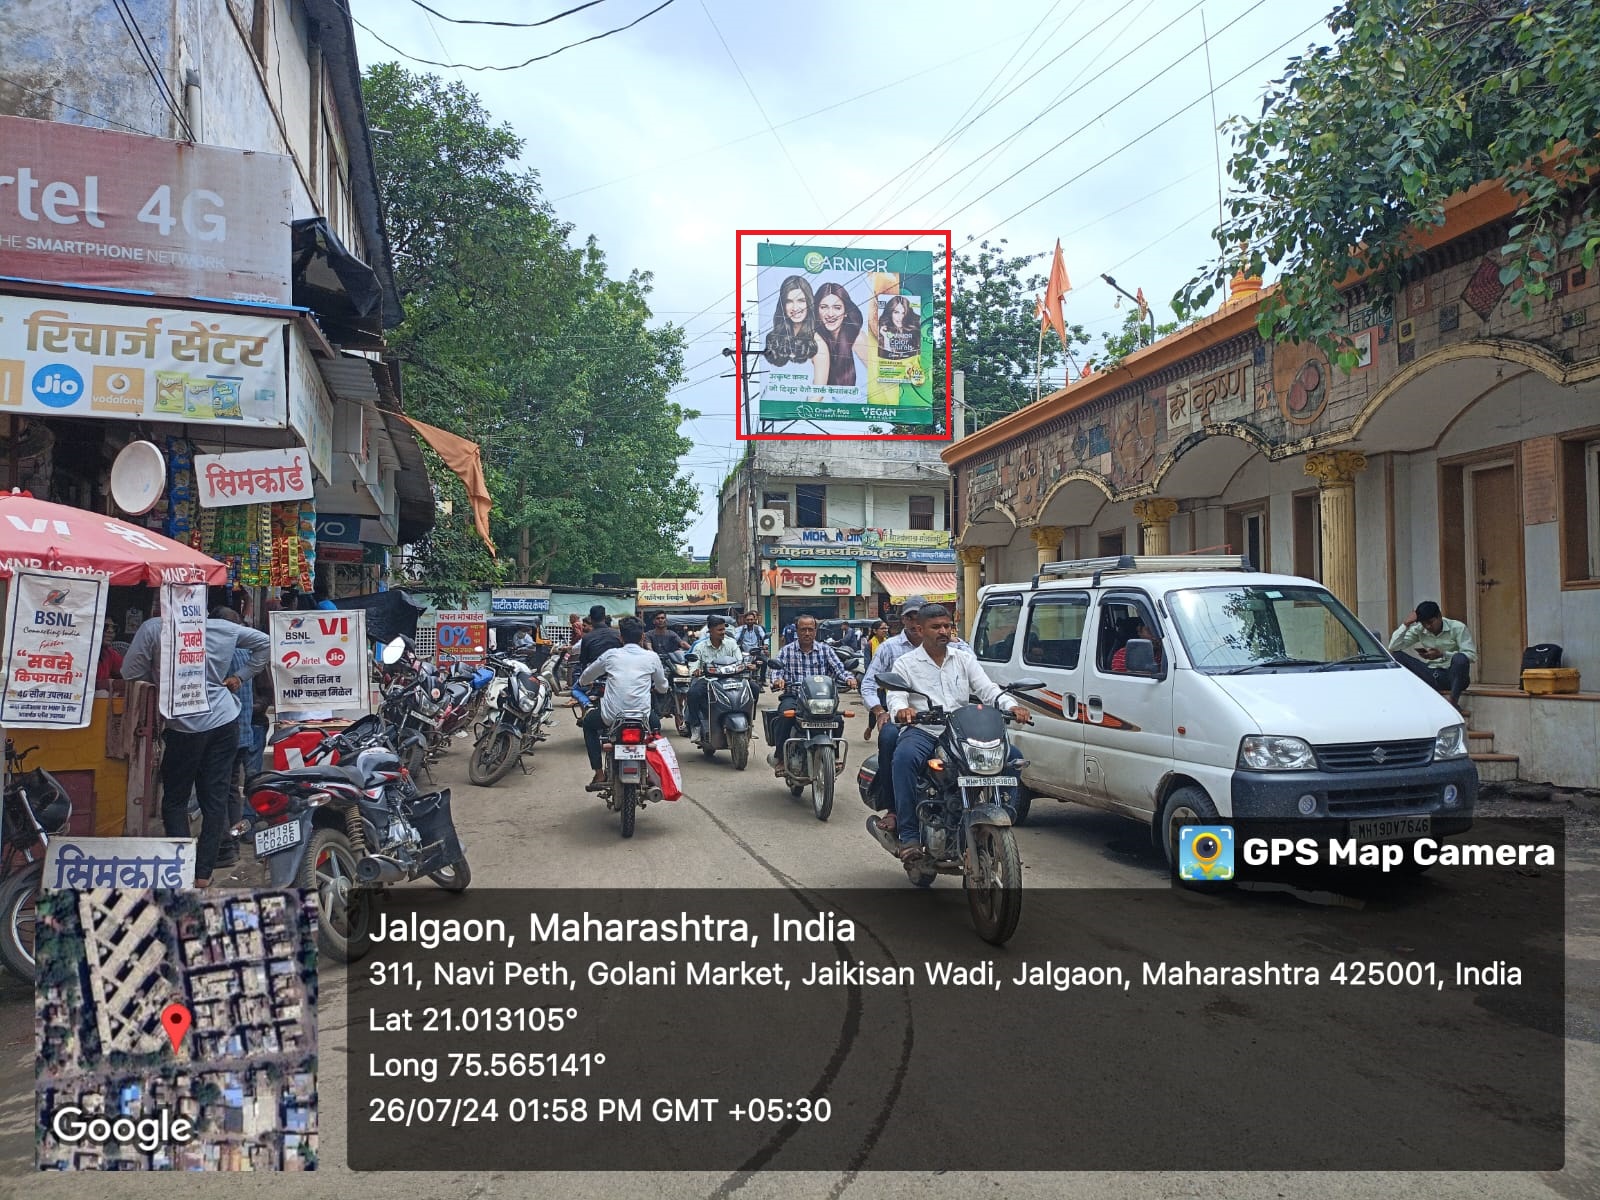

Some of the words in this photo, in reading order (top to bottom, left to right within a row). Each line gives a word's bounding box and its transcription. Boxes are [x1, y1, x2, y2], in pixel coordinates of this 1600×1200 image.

[137, 184, 226, 243] 4G
[26, 237, 144, 261] SMARTPHONE
[147, 249, 225, 268] NETWORK
[805, 254, 888, 272] GARNIER
[24, 310, 162, 359] रिचार्ज
[168, 321, 268, 367] सेंटर
[36, 373, 78, 394] Jio
[93, 395, 143, 405] vodafone
[1190, 360, 1252, 425] कृष्ण
[861, 407, 896, 416] VEGAN
[205, 456, 304, 498] सिमकार्ड
[5, 515, 71, 535] VI
[770, 544, 815, 557] मोहन
[879, 548, 907, 559] हाल
[160, 567, 188, 582] MNP
[680, 580, 699, 591] आणि
[701, 580, 723, 591] कंपनी
[34, 610, 76, 628] BSNL
[318, 617, 348, 635] VI
[439, 625, 472, 647] 0%
[301, 657, 320, 665] airtel
[328, 652, 344, 661] Jio
[317, 674, 334, 684] सिम
[335, 675, 341, 683] व
[17, 690, 28, 698] 4G
[283, 689, 303, 698] MNP
[1359, 819, 1429, 839] MH19DV7646
[55, 844, 185, 888] सिमकार्ड
